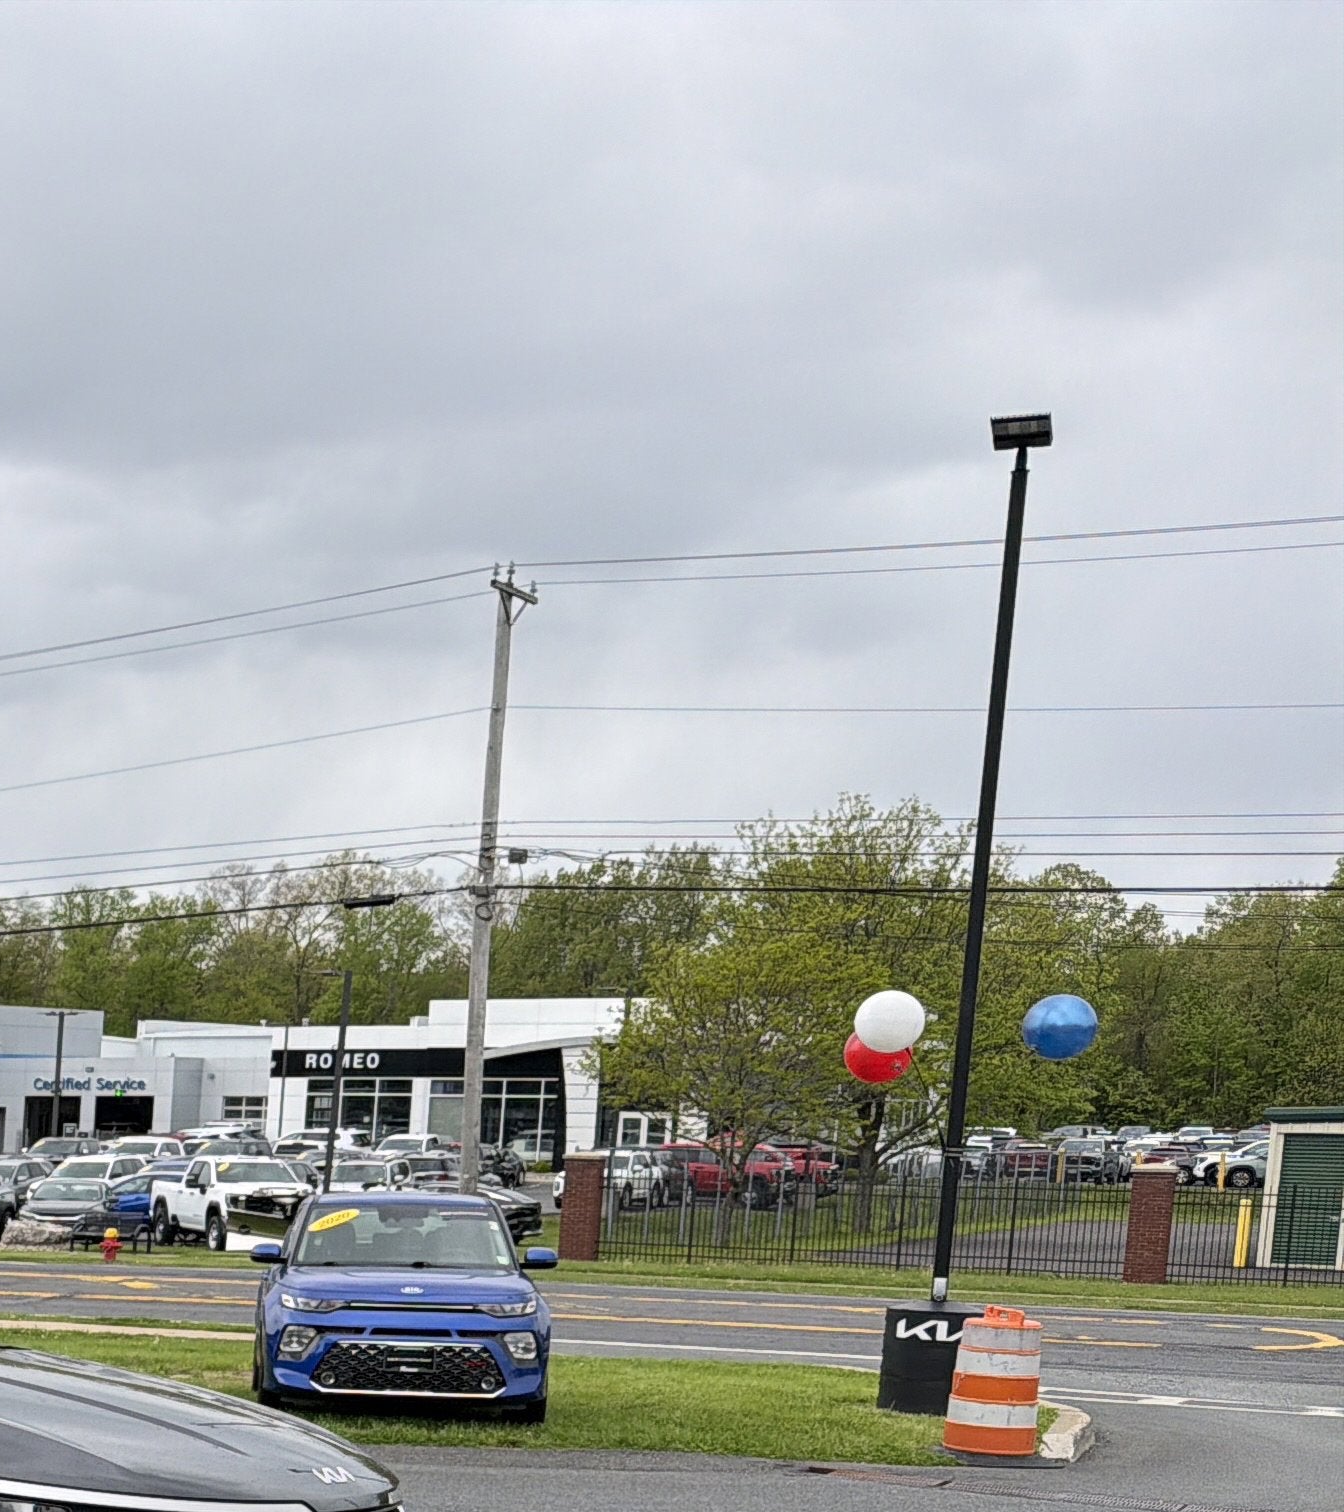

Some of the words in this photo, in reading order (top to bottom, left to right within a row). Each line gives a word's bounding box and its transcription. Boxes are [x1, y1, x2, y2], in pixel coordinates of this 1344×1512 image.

[33, 1077, 91, 1091] Cerified
[95, 1077, 146, 1090] Service
[319, 1212, 350, 1227] 2020
